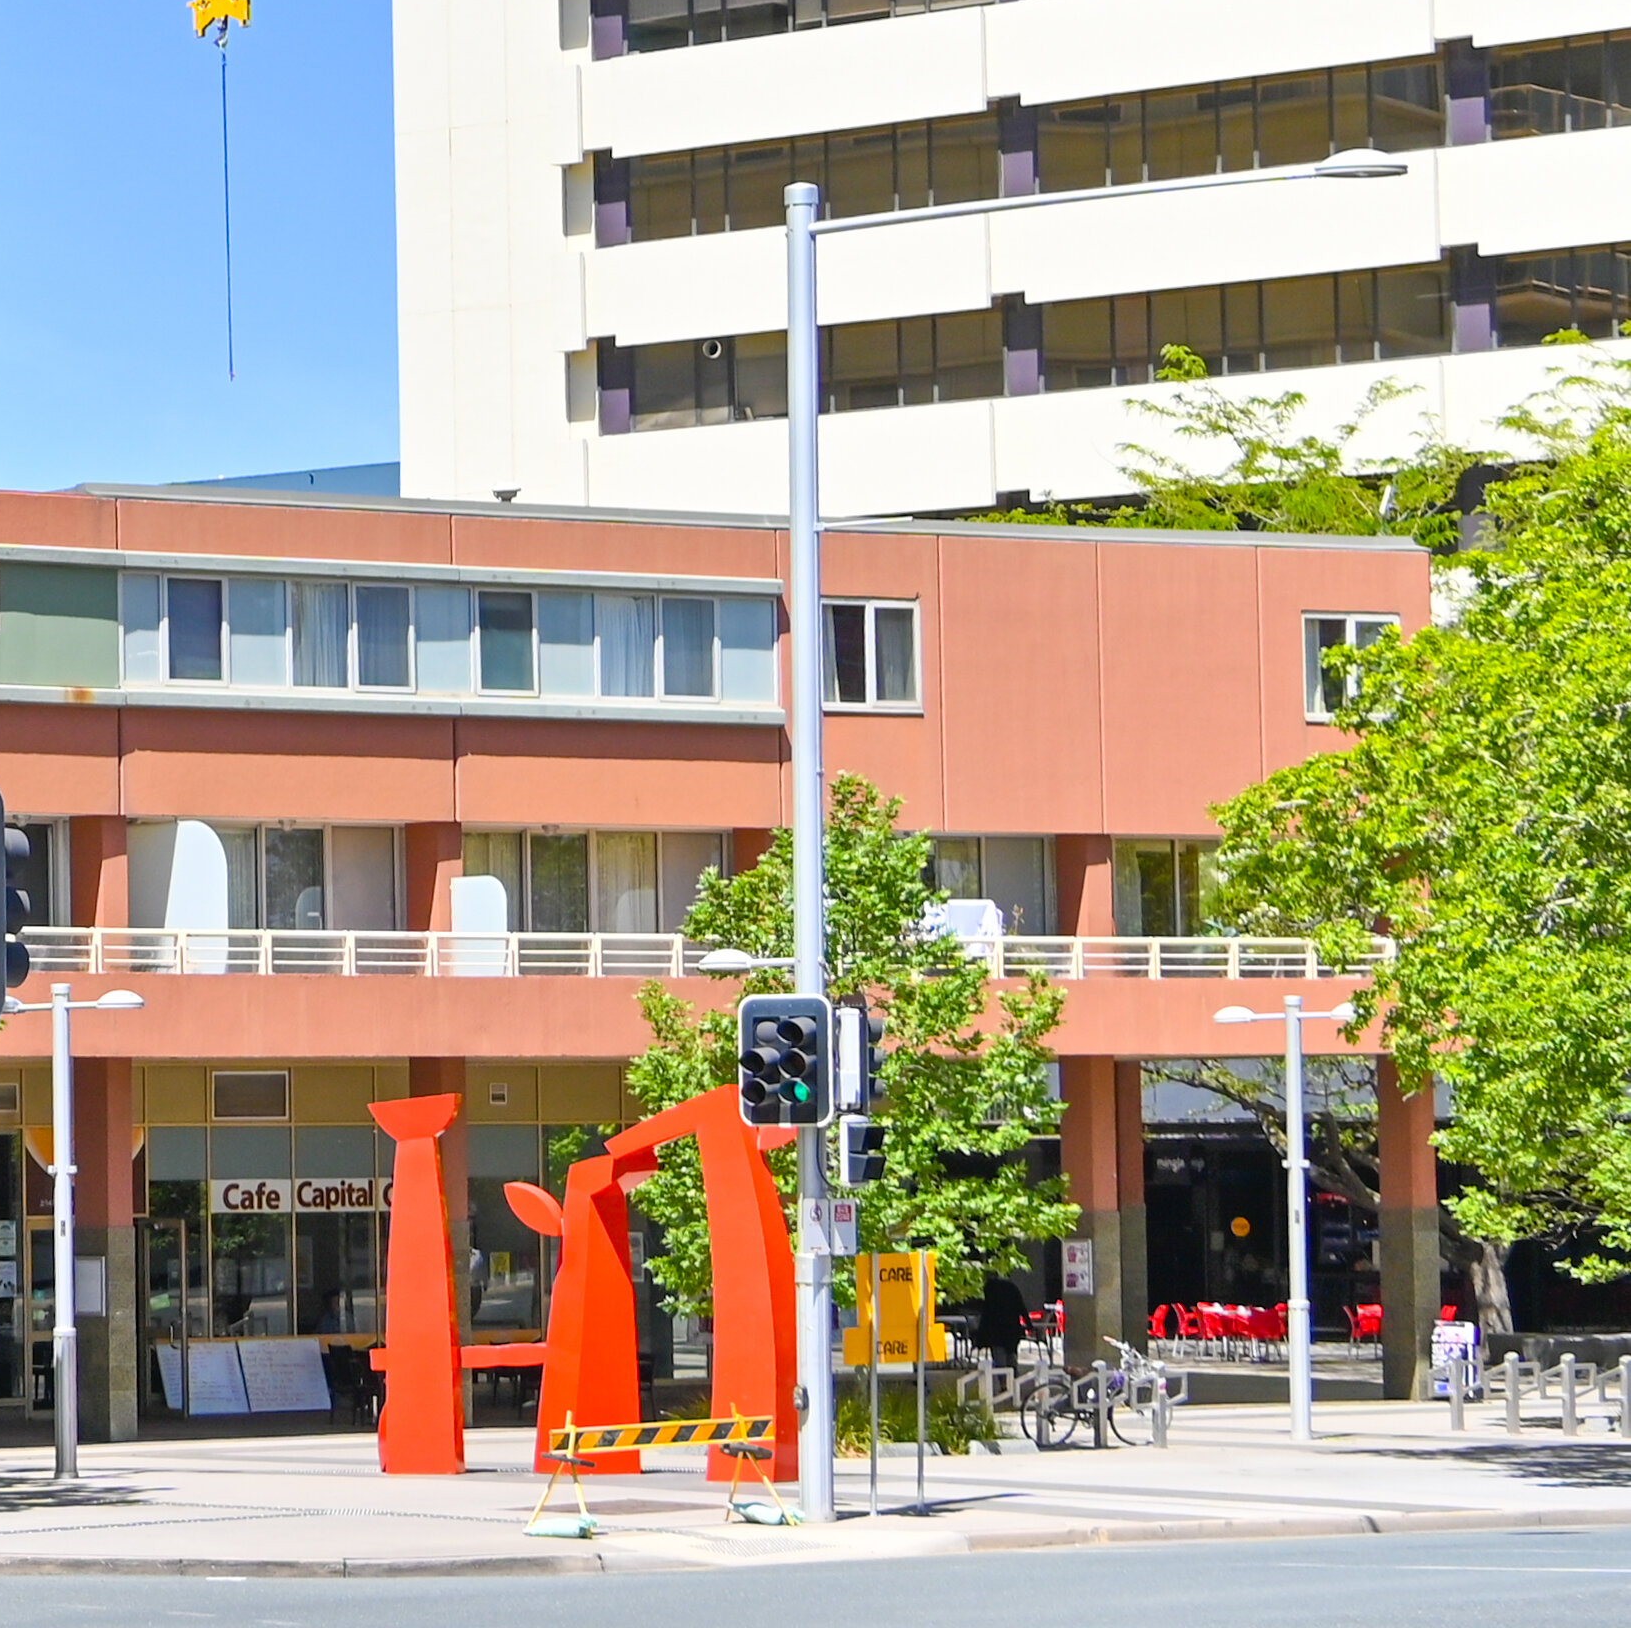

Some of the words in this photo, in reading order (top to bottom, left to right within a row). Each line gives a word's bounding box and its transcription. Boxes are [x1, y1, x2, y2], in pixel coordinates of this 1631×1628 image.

[223, 1182, 280, 1210] Cafe
[297, 1180, 374, 1210] Capital
[879, 1267, 913, 1283] CARE
